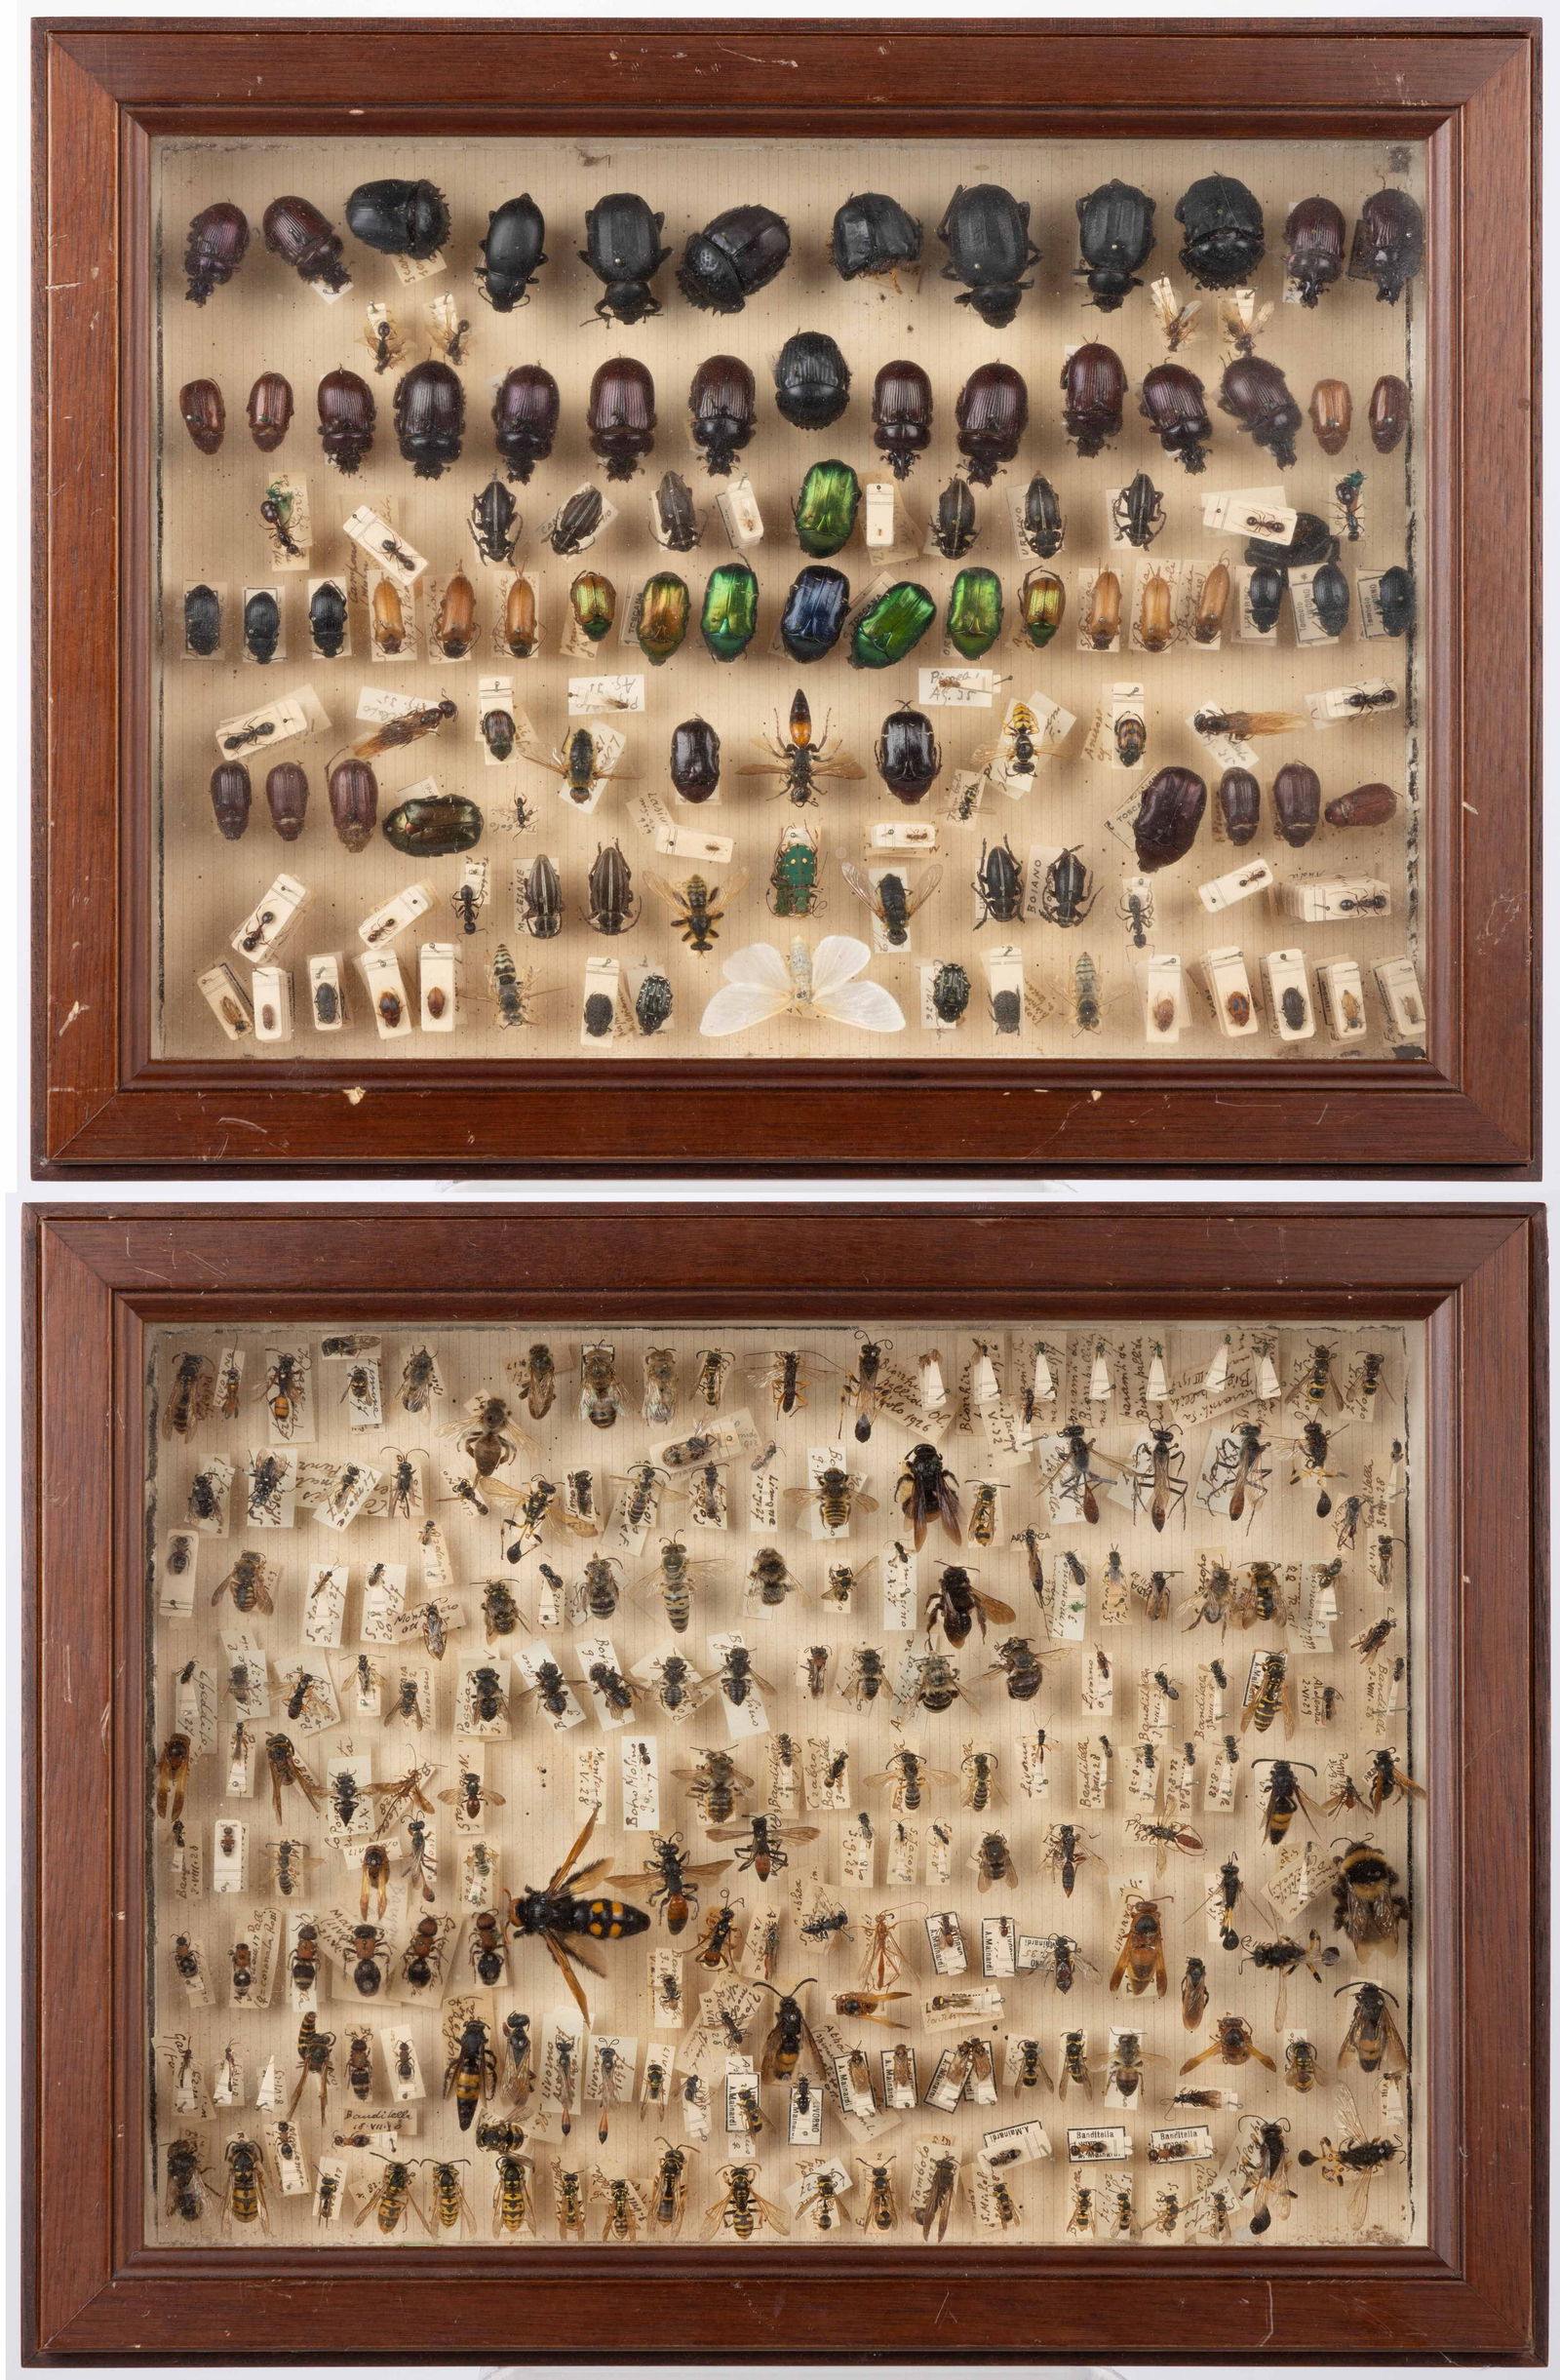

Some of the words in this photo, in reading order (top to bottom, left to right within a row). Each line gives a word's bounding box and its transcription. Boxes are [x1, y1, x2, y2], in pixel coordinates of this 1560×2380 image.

[516, 869, 526, 915] CESANE
[1028, 859, 1041, 914] BOIANO
[1011, 1532, 1051, 1543] ARDNZA
[840, 2075, 852, 2107] Mainardi
[344, 2110, 412, 2120] Banditella
[989, 2126, 1032, 2143] A.Mainardi
[1160, 2130, 1198, 2139] Banditella
[911, 2146, 929, 2202] Tombolo
